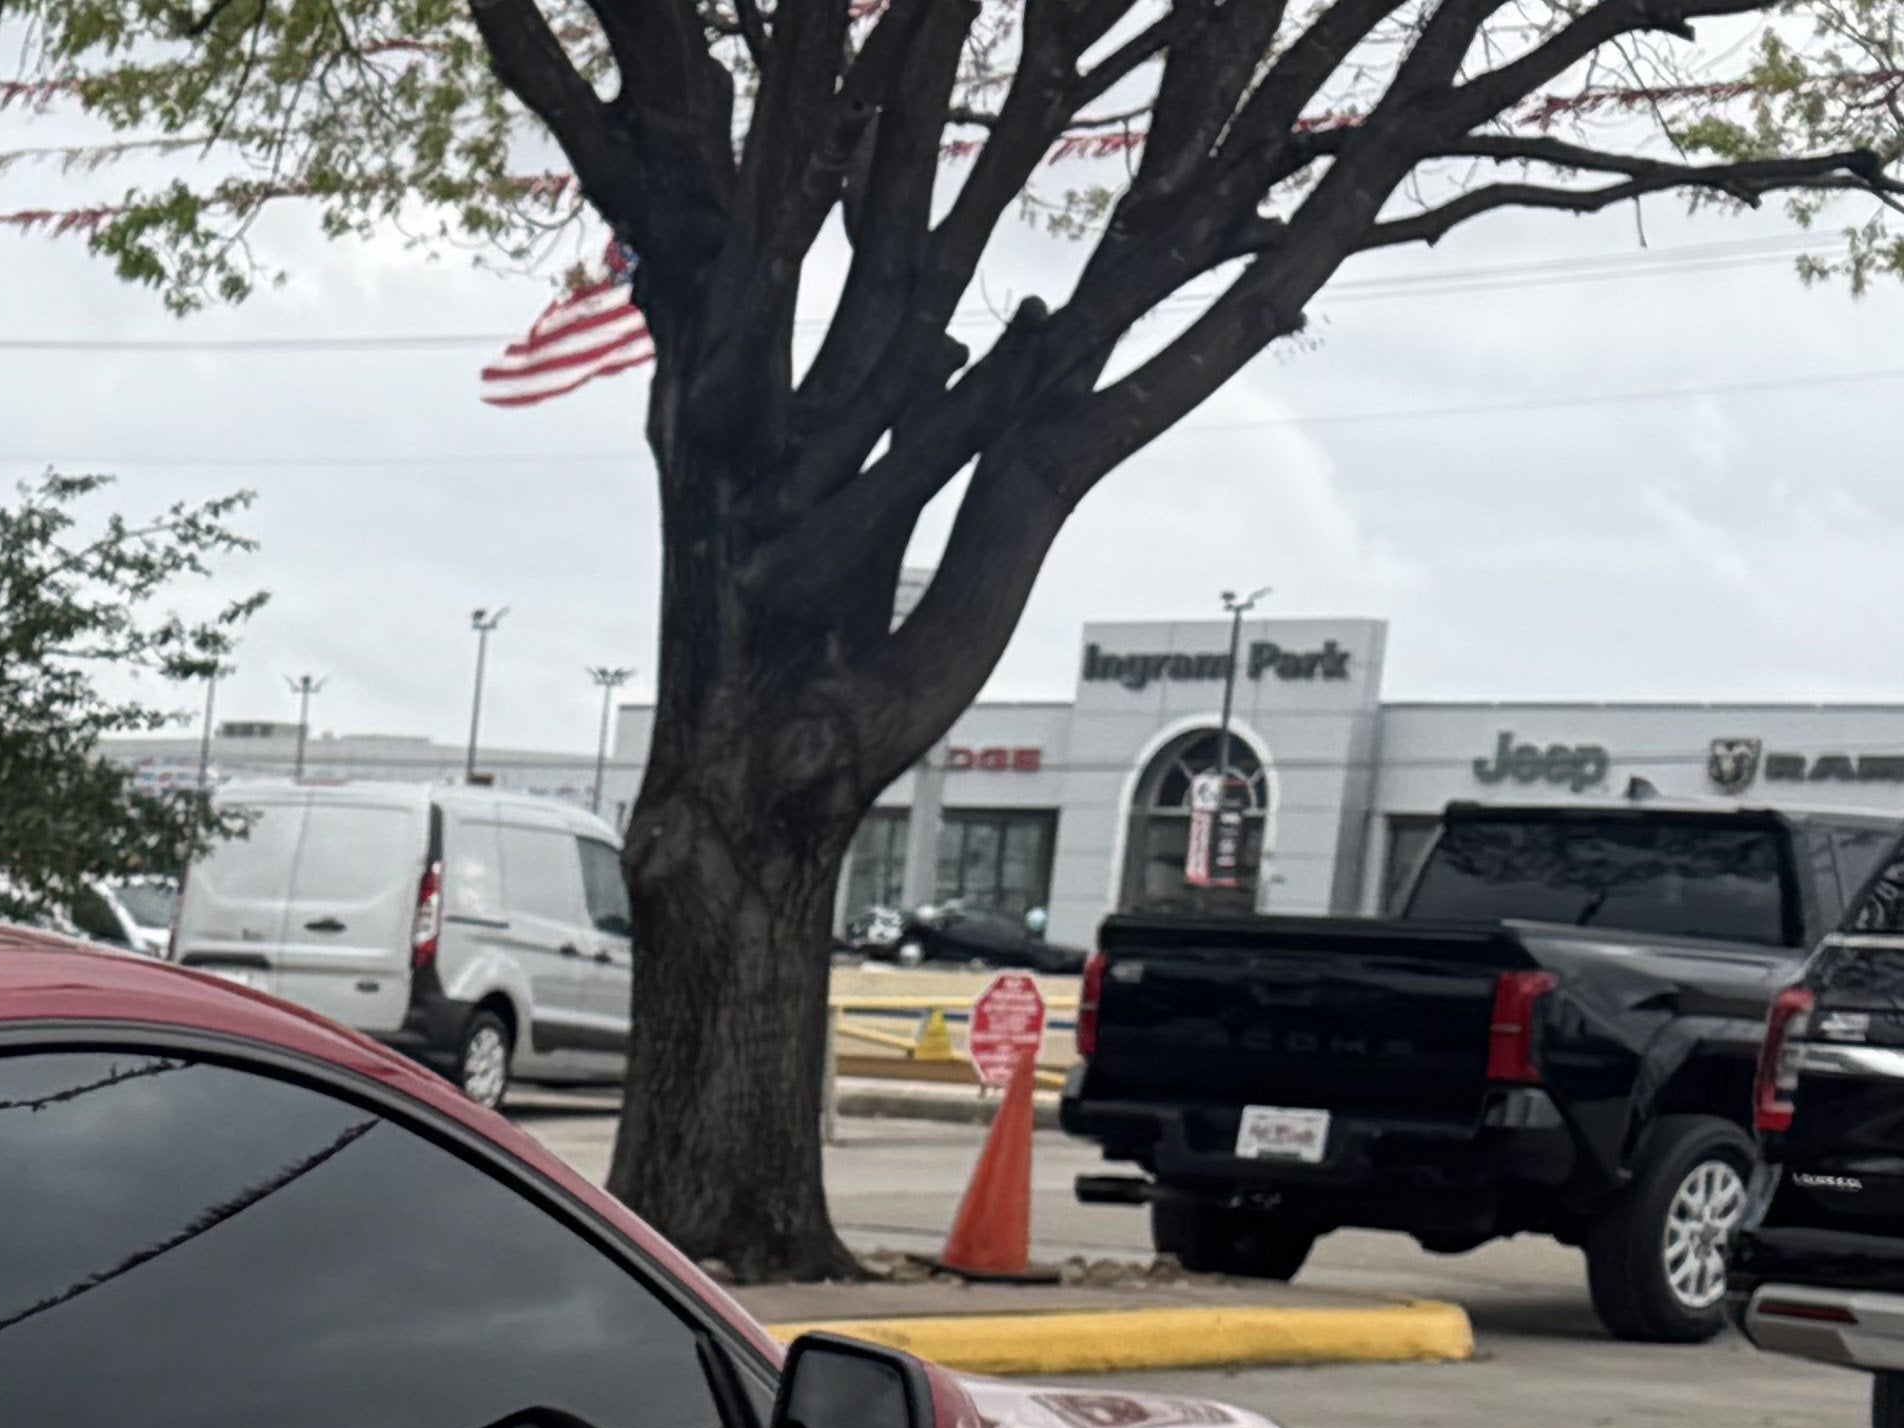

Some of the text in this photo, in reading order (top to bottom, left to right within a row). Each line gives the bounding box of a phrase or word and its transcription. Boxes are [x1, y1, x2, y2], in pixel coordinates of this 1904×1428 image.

[1082, 640, 1350, 691] Ingram Park
[1473, 730, 1611, 794] Jeep
